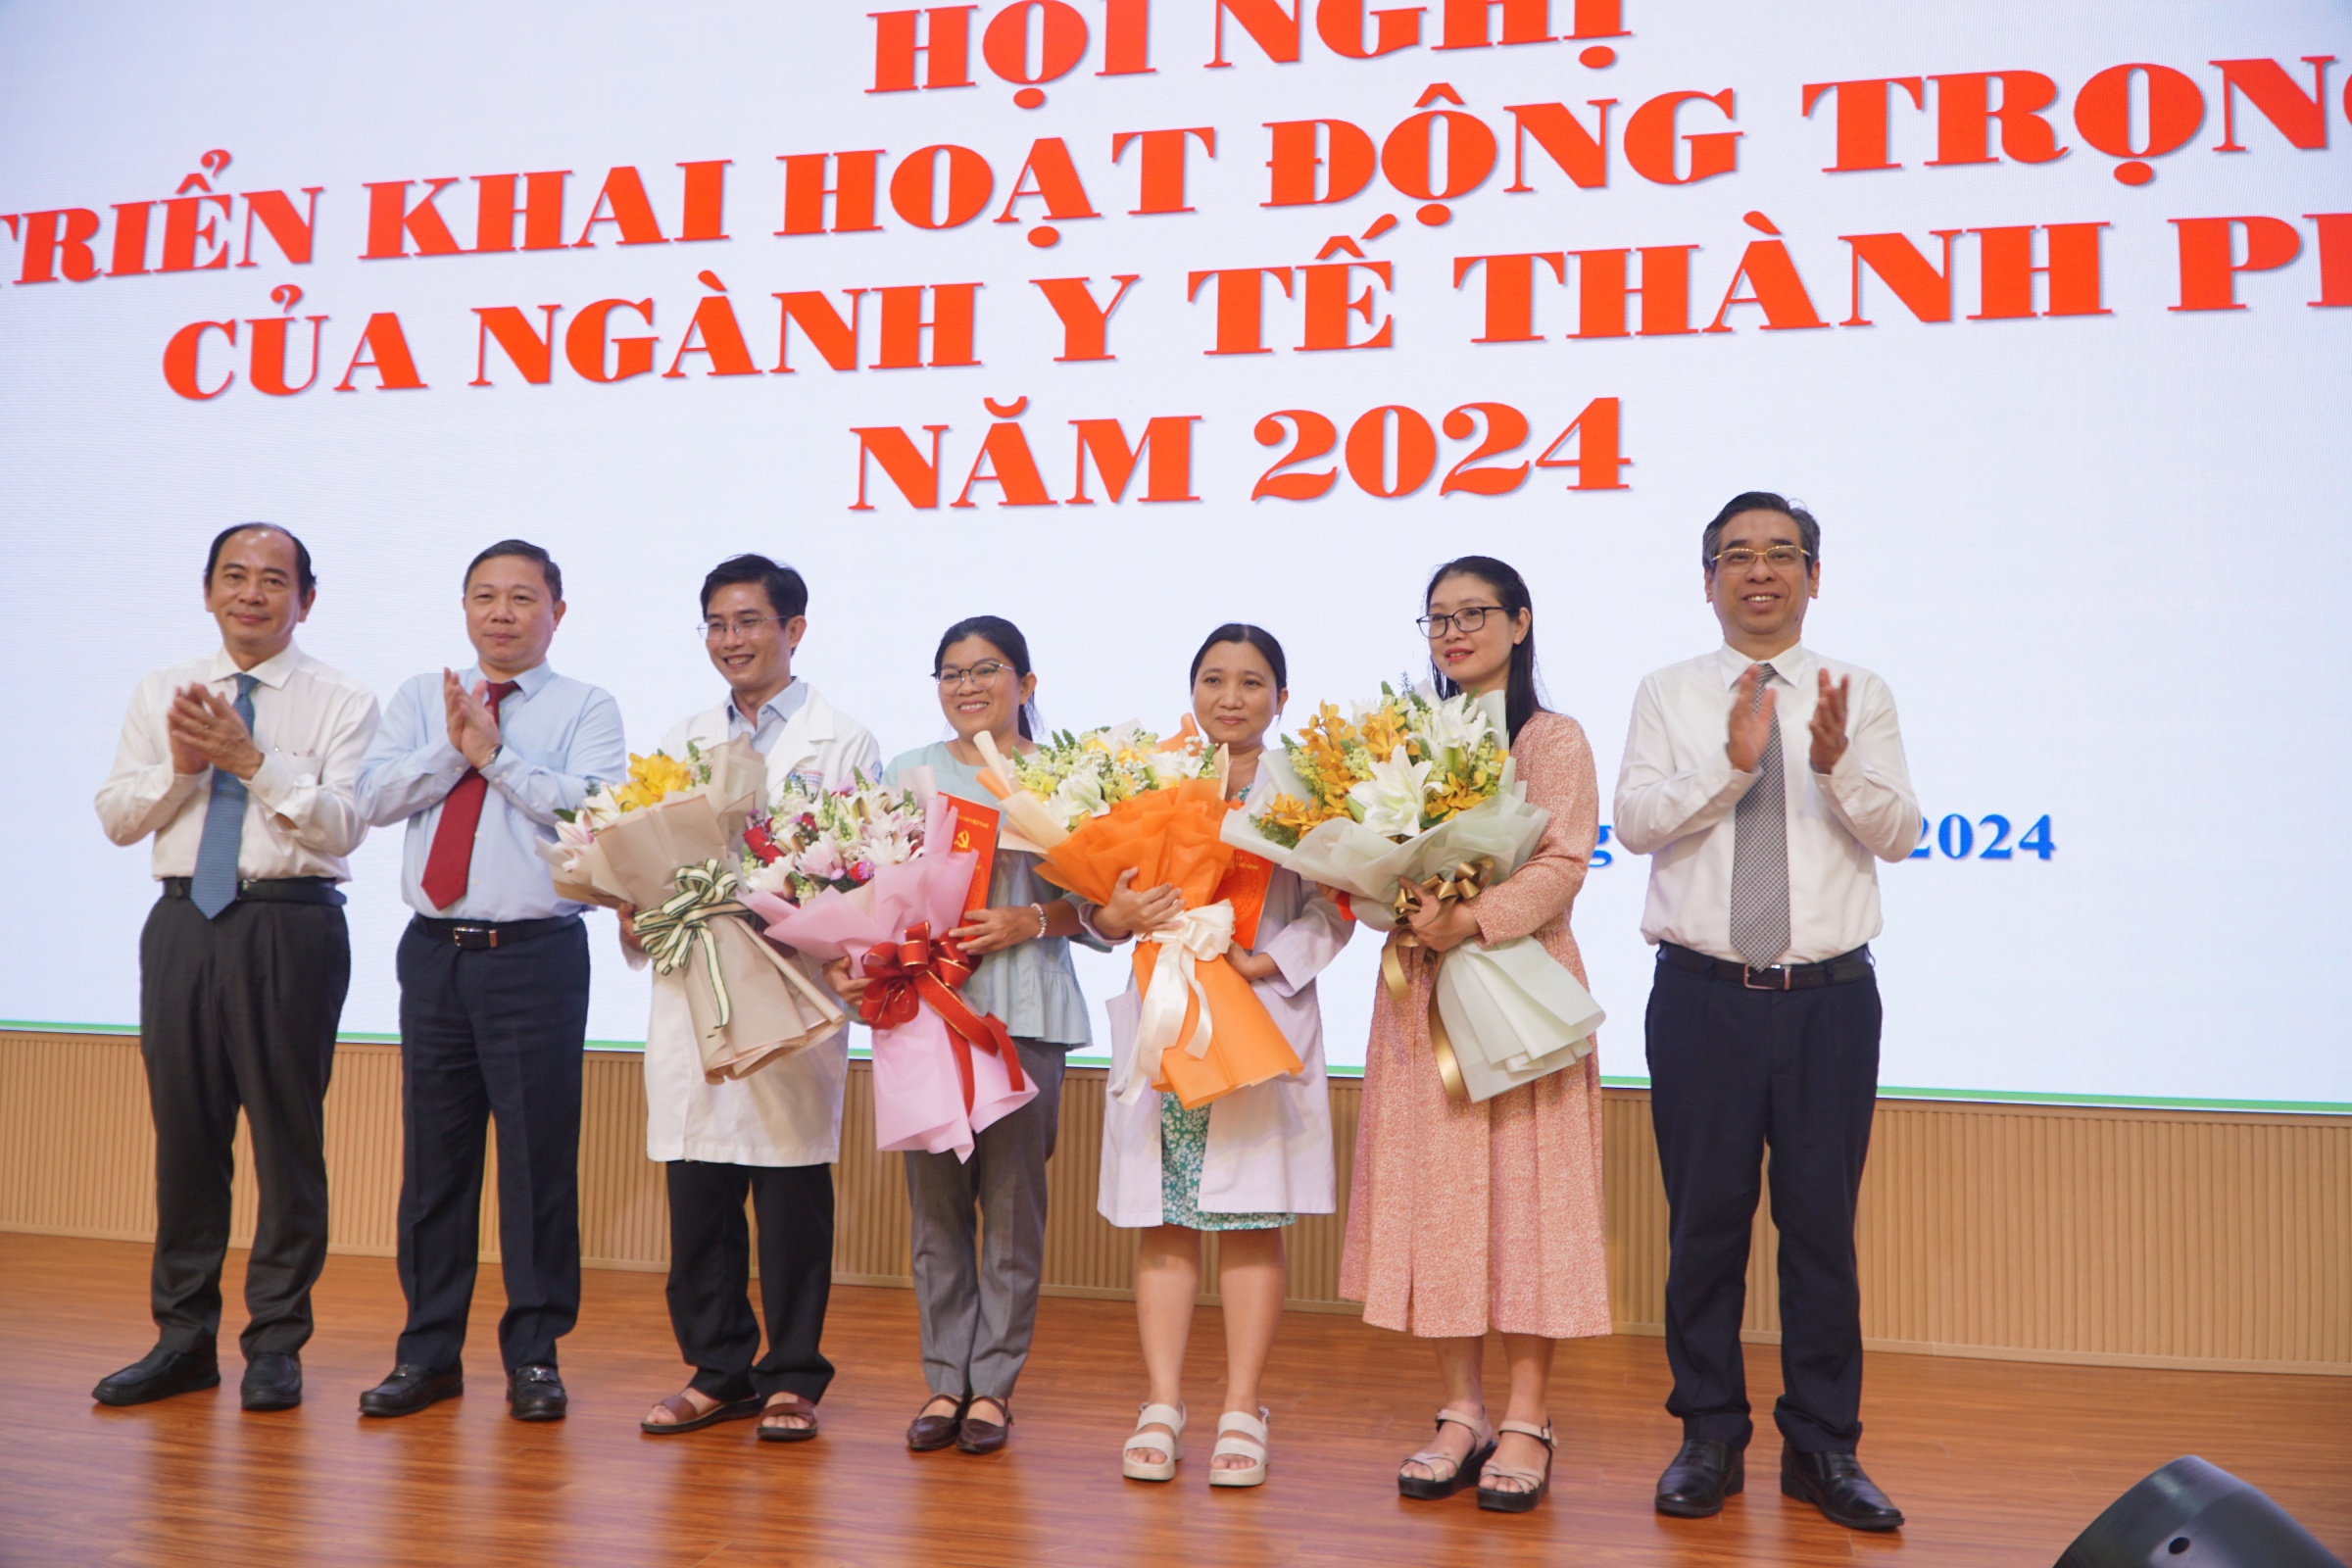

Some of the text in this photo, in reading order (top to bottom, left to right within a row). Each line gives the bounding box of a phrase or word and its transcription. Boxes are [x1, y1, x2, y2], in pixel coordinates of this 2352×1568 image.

[0, 56, 2352, 285] RIỂN KHAI HOẠT ĐỘNG TRỌN
[163, 284, 428, 402] CỦA
[468, 270, 985, 387] NGÀNH
[1029, 274, 1141, 363] Y
[1187, 213, 1397, 356] TẾ
[1453, 211, 2113, 343] THÀNH
[848, 396, 1633, 512] NĂM 2024
